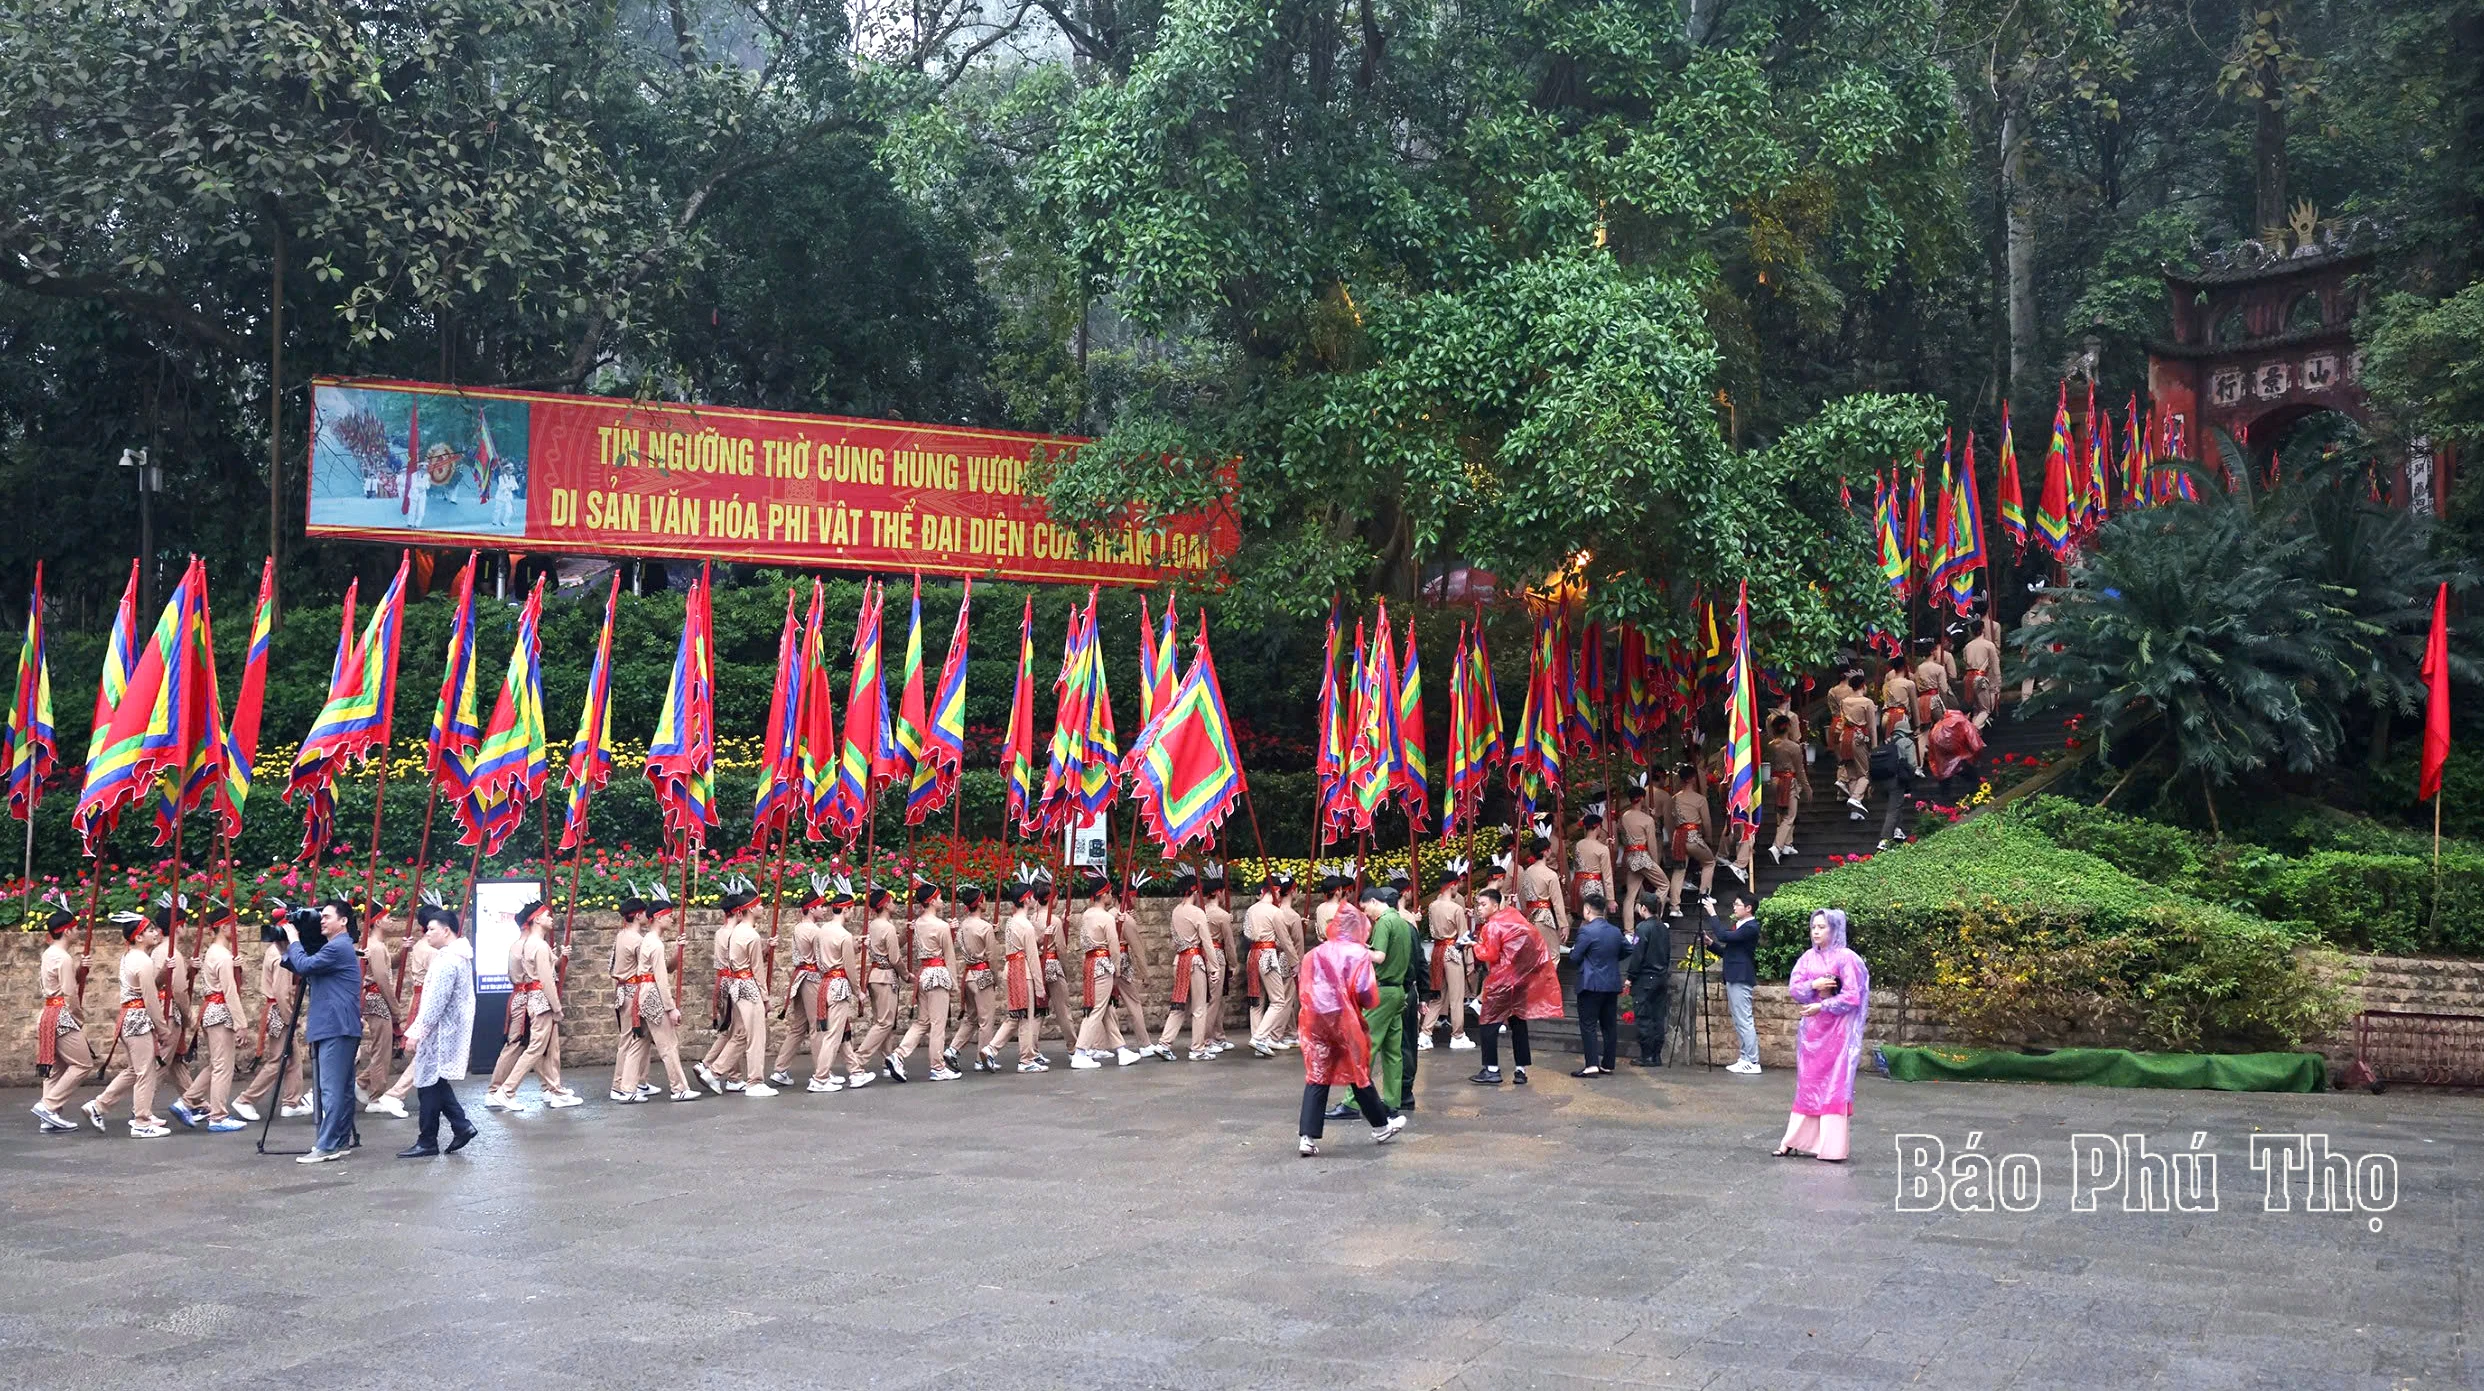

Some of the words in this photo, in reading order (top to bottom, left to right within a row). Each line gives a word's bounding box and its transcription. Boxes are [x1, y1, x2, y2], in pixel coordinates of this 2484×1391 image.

[596, 420, 639, 468] TÍN
[648, 426, 755, 479] NGƯỠNG
[762, 432, 811, 481] THỜ
[818, 437, 885, 486] CÚNG
[893, 443, 959, 491] HÙNG
[967, 454, 1048, 498] VƯƠN
[551, 488, 577, 528] DI
[586, 475, 640, 533] SẢN
[649, 484, 701, 537] VĂN
[708, 492, 760, 541] HÓA
[767, 503, 809, 544] PHI
[818, 500, 863, 554] VẬT
[870, 496, 915, 550] THỂ
[921, 514, 961, 561] ĐẠI
[970, 512, 1025, 564] DIỆN
